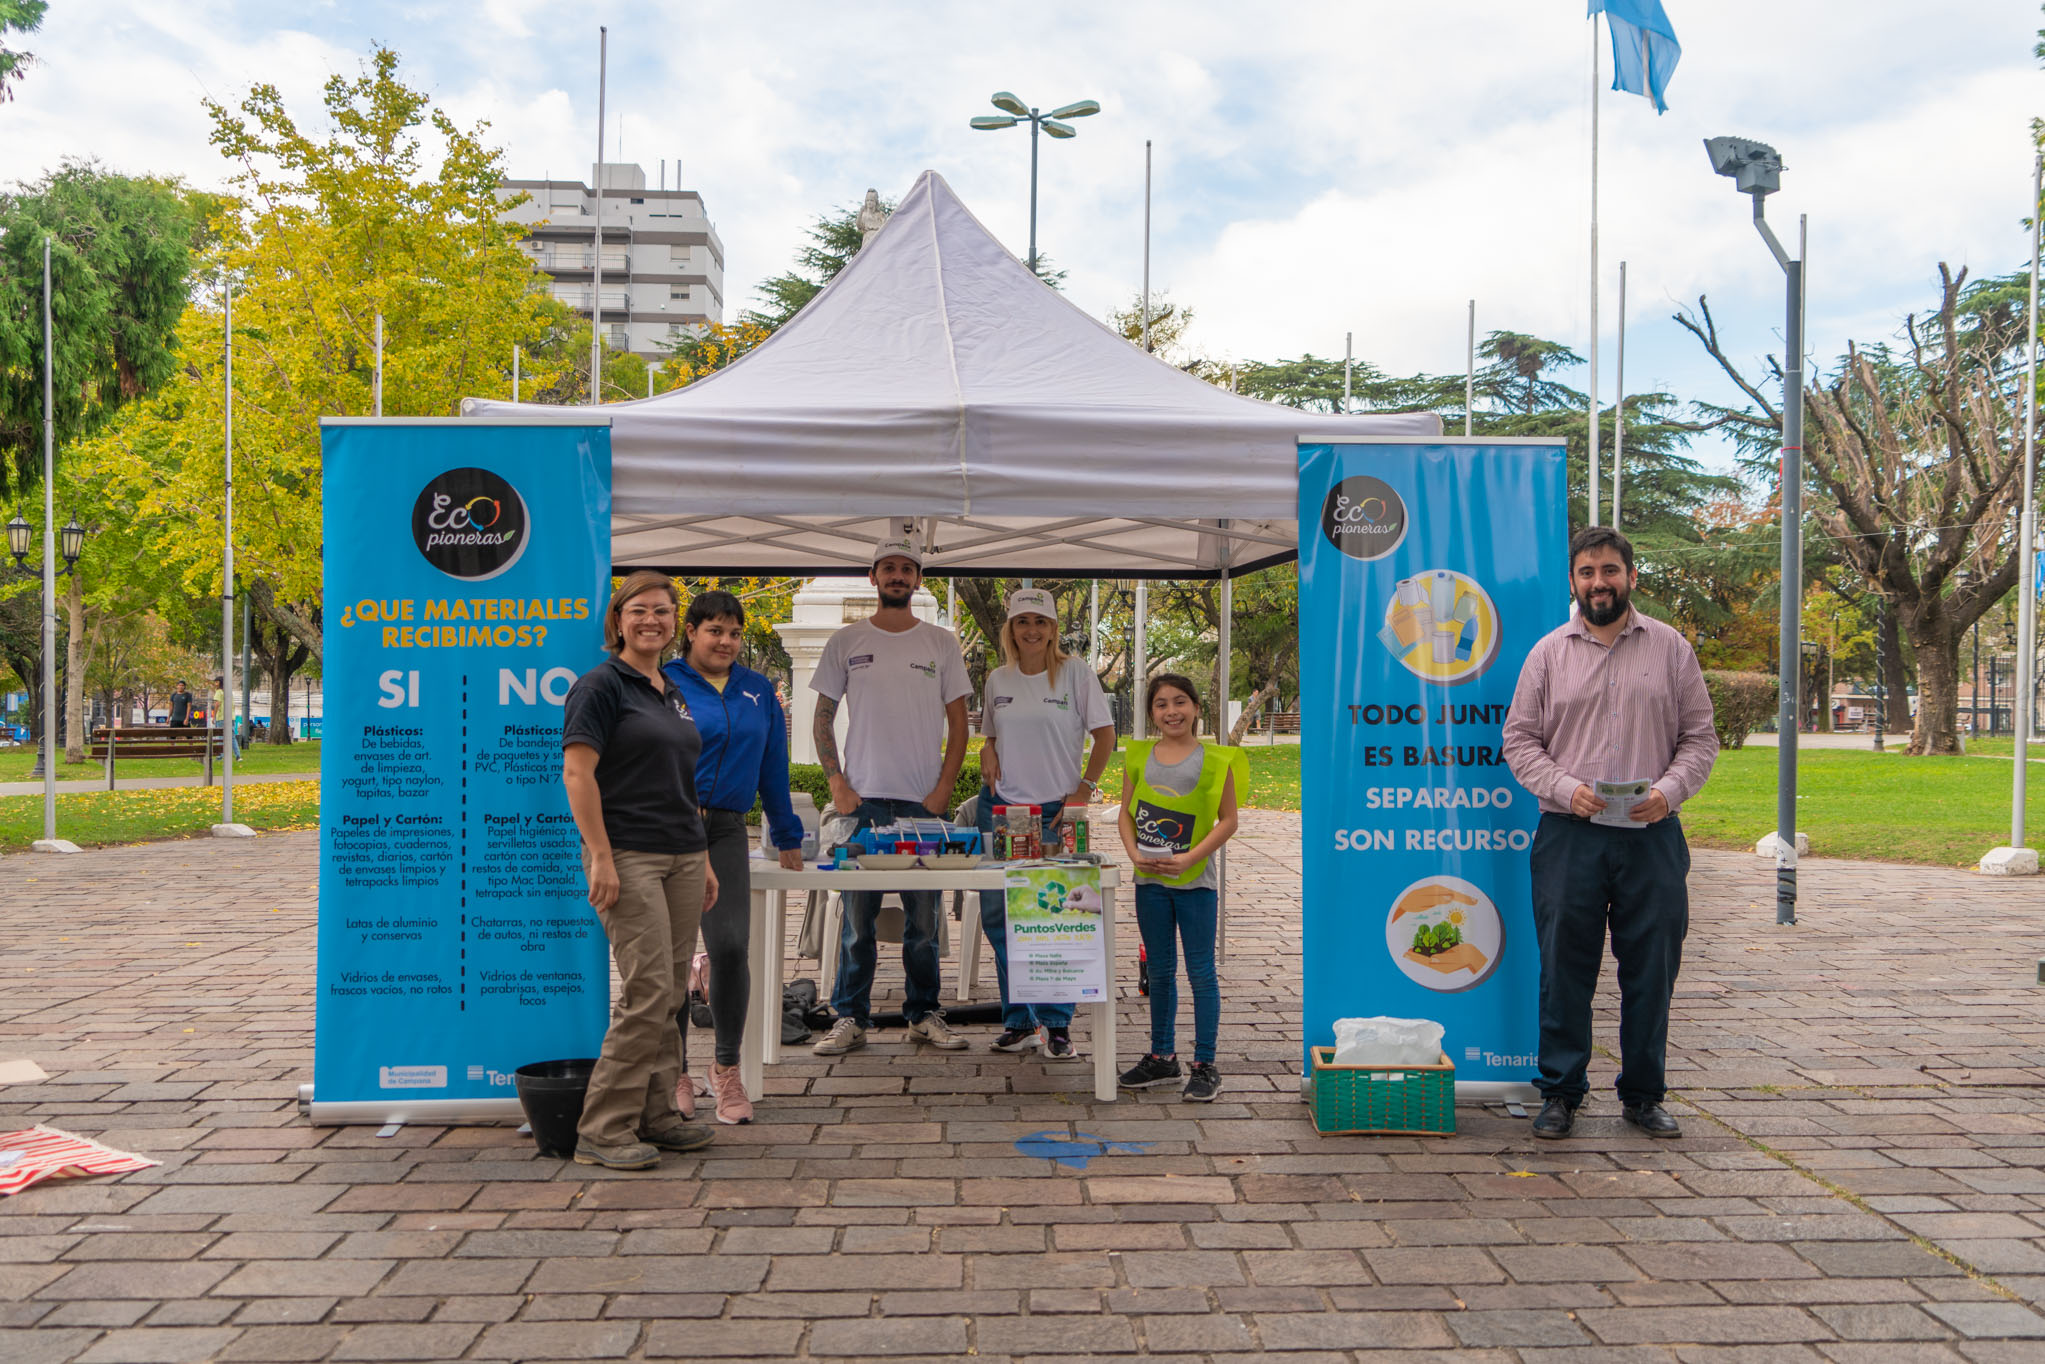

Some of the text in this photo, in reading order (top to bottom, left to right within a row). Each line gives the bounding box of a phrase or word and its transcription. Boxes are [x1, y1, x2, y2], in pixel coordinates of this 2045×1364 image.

[426, 530, 506, 551] pioneras
[1332, 522, 1390, 539] pioneras
[340, 598, 590, 628] ¿QUE MATERIALES
[383, 625, 548, 648] RECIBIMOS?
[377, 666, 579, 709] SI NO
[1348, 704, 1511, 725] TODO JUNT
[364, 725, 423, 736] Plásticos:
[504, 724, 562, 736] Plásticos:
[1364, 746, 1393, 767] ES
[1366, 787, 1513, 809] SEPARADO
[343, 814, 443, 828] Papel y Cartón:
[484, 813, 520, 826] Papel
[524, 816, 532, 826] y
[1334, 829, 1536, 851] SON RECURSO
